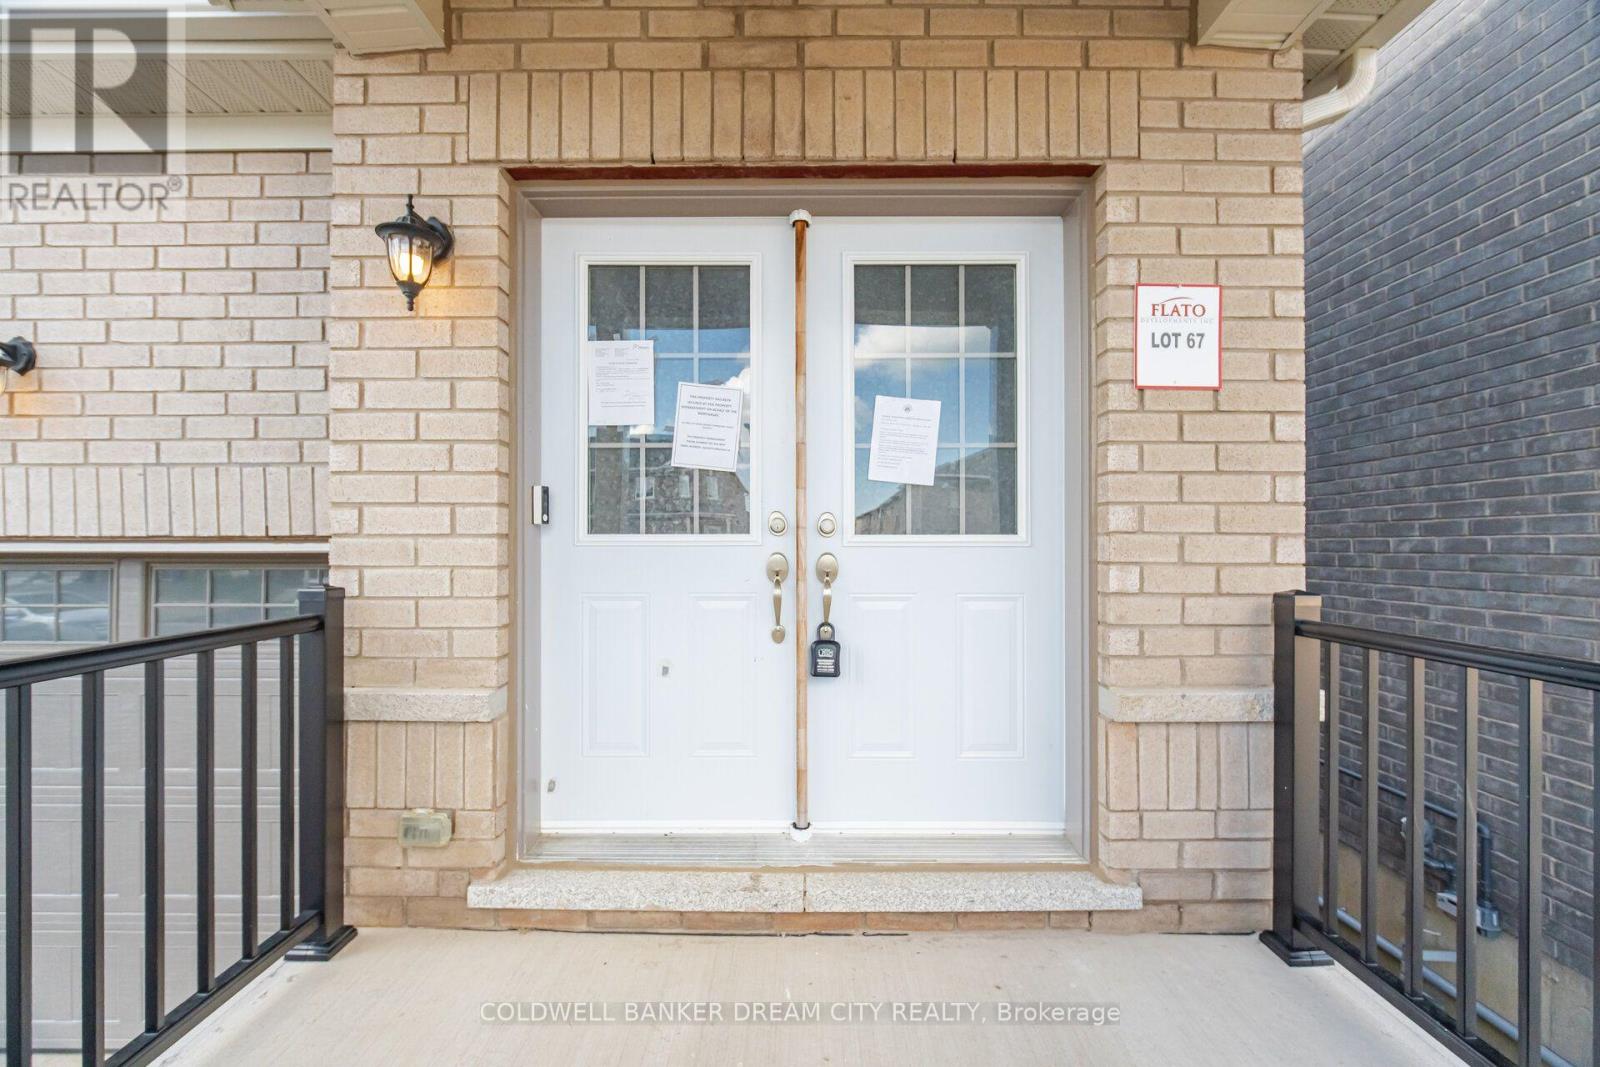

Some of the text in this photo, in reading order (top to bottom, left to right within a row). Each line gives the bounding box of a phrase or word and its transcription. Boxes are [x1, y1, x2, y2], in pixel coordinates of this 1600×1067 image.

[1151, 303, 1206, 318] FLATO
[1151, 332, 1206, 349] LOT 67
